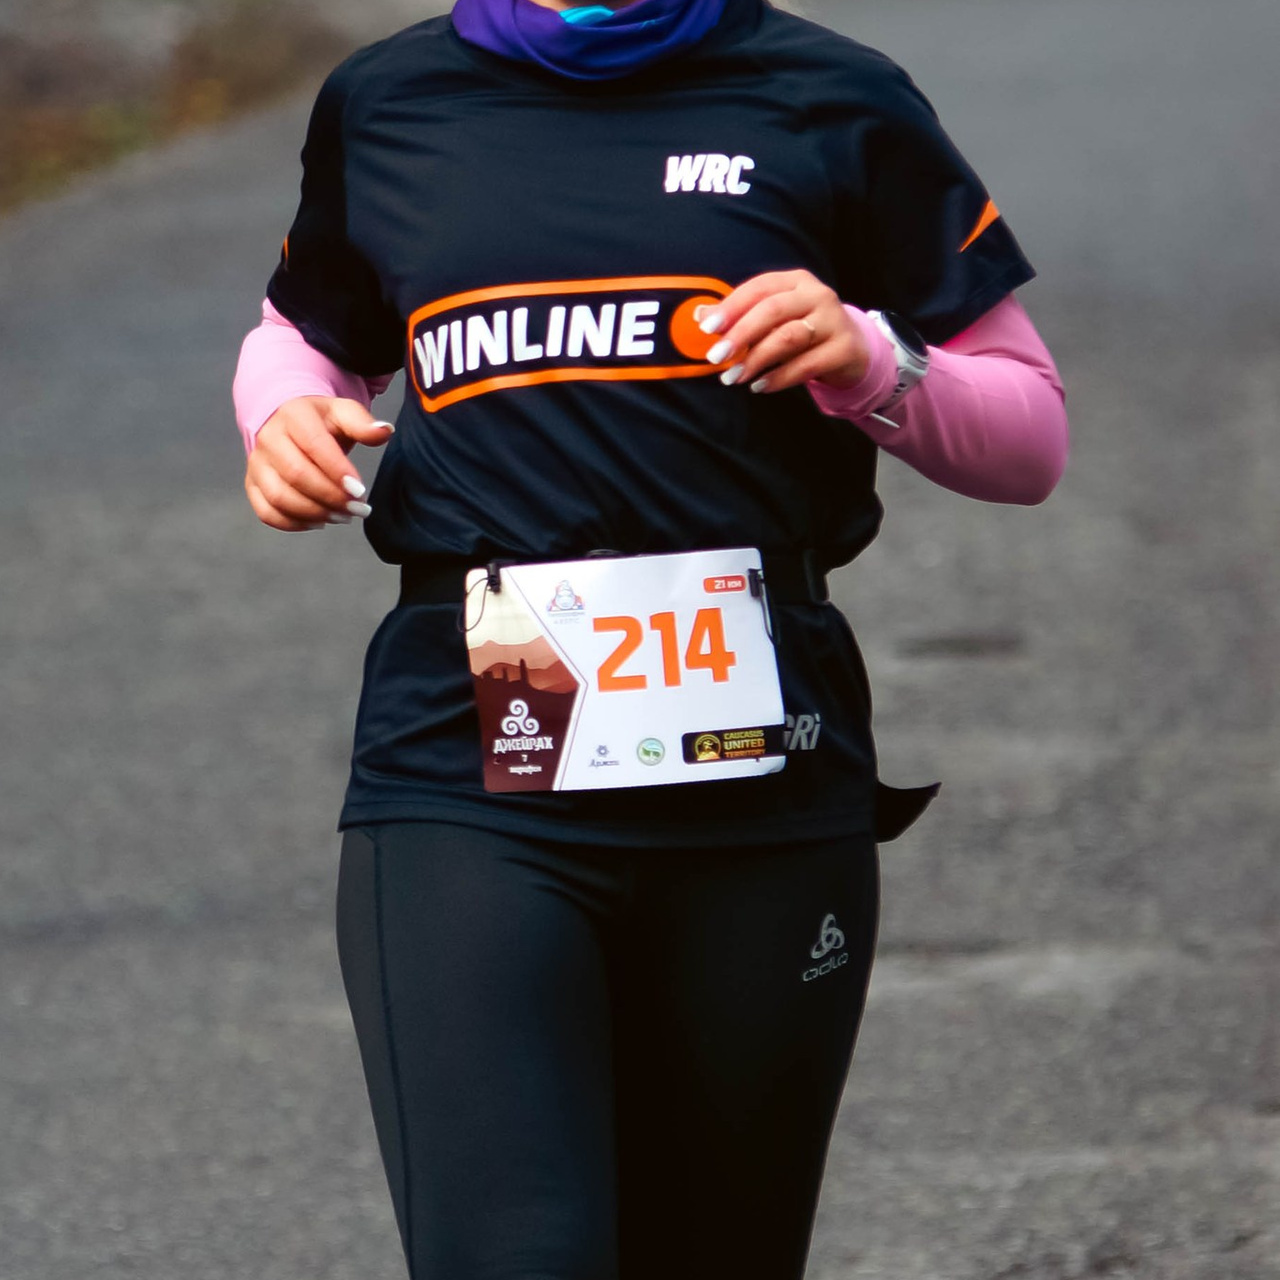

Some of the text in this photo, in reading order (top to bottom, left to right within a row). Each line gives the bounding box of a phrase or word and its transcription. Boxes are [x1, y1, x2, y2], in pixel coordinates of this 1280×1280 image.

[664, 153, 755, 196] WRC
[414, 300, 661, 390] WINLINE
[714, 579, 726, 590] 21
[592, 606, 737, 692] 214
[724, 729, 765, 740] CAUCASUS
[493, 736, 554, 755] ДЖЕЙРАХ
[724, 738, 766, 751] UNITED
